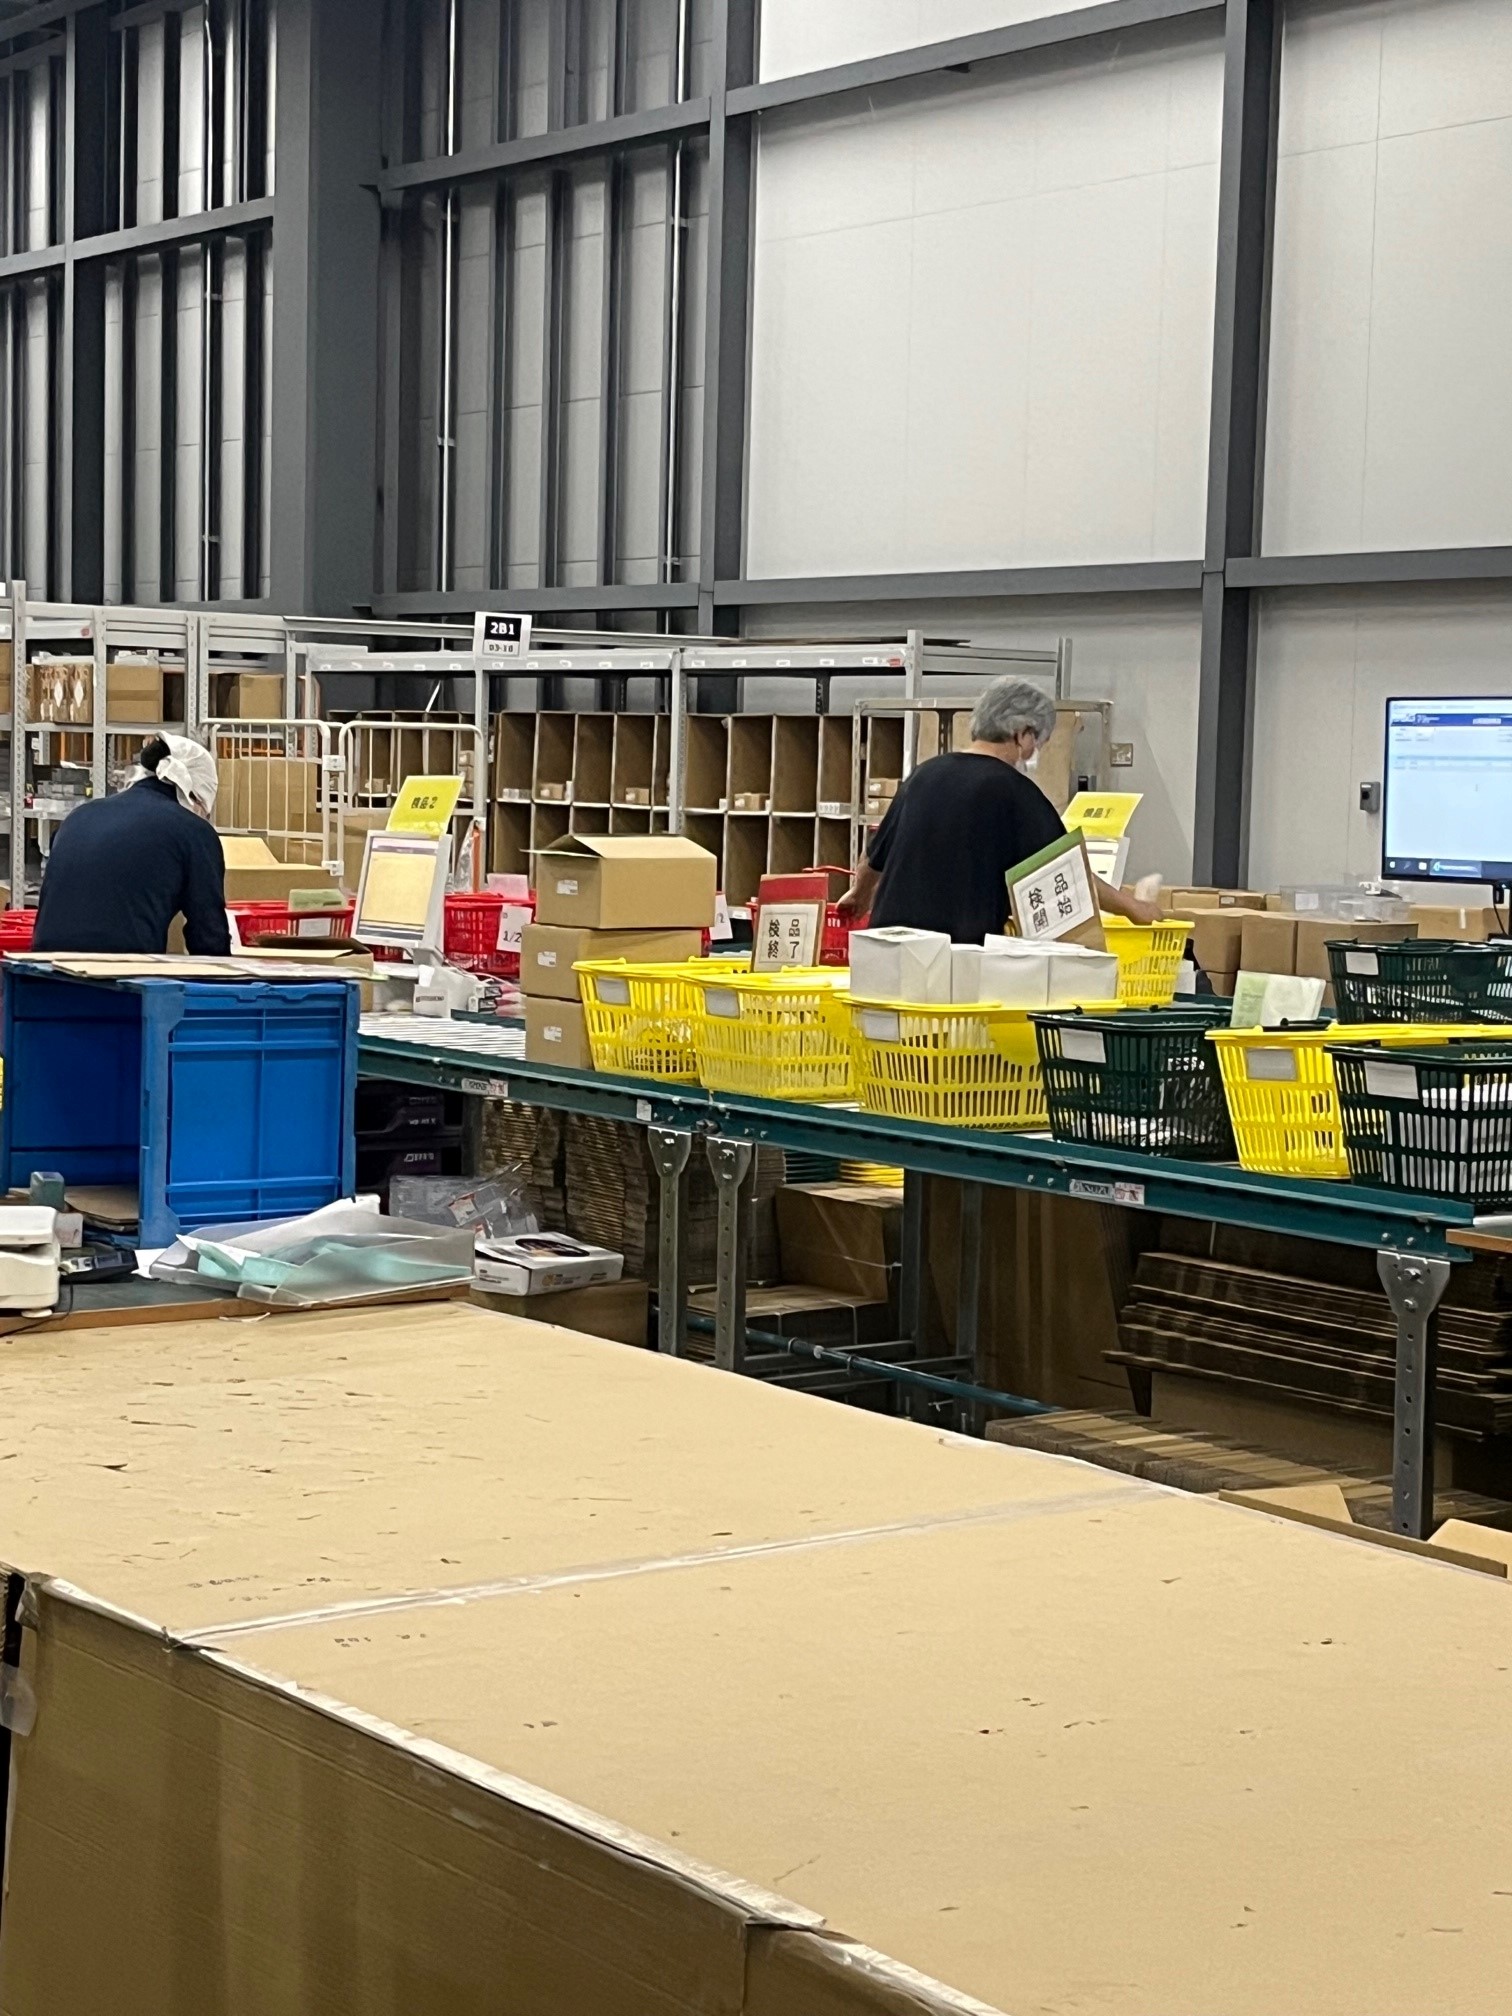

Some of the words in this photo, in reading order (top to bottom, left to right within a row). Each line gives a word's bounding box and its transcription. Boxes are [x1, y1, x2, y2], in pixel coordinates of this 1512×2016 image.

[490, 621, 515, 635] 2B1
[1028, 872, 1069, 910] 検品
[1032, 894, 1073, 933] 開始
